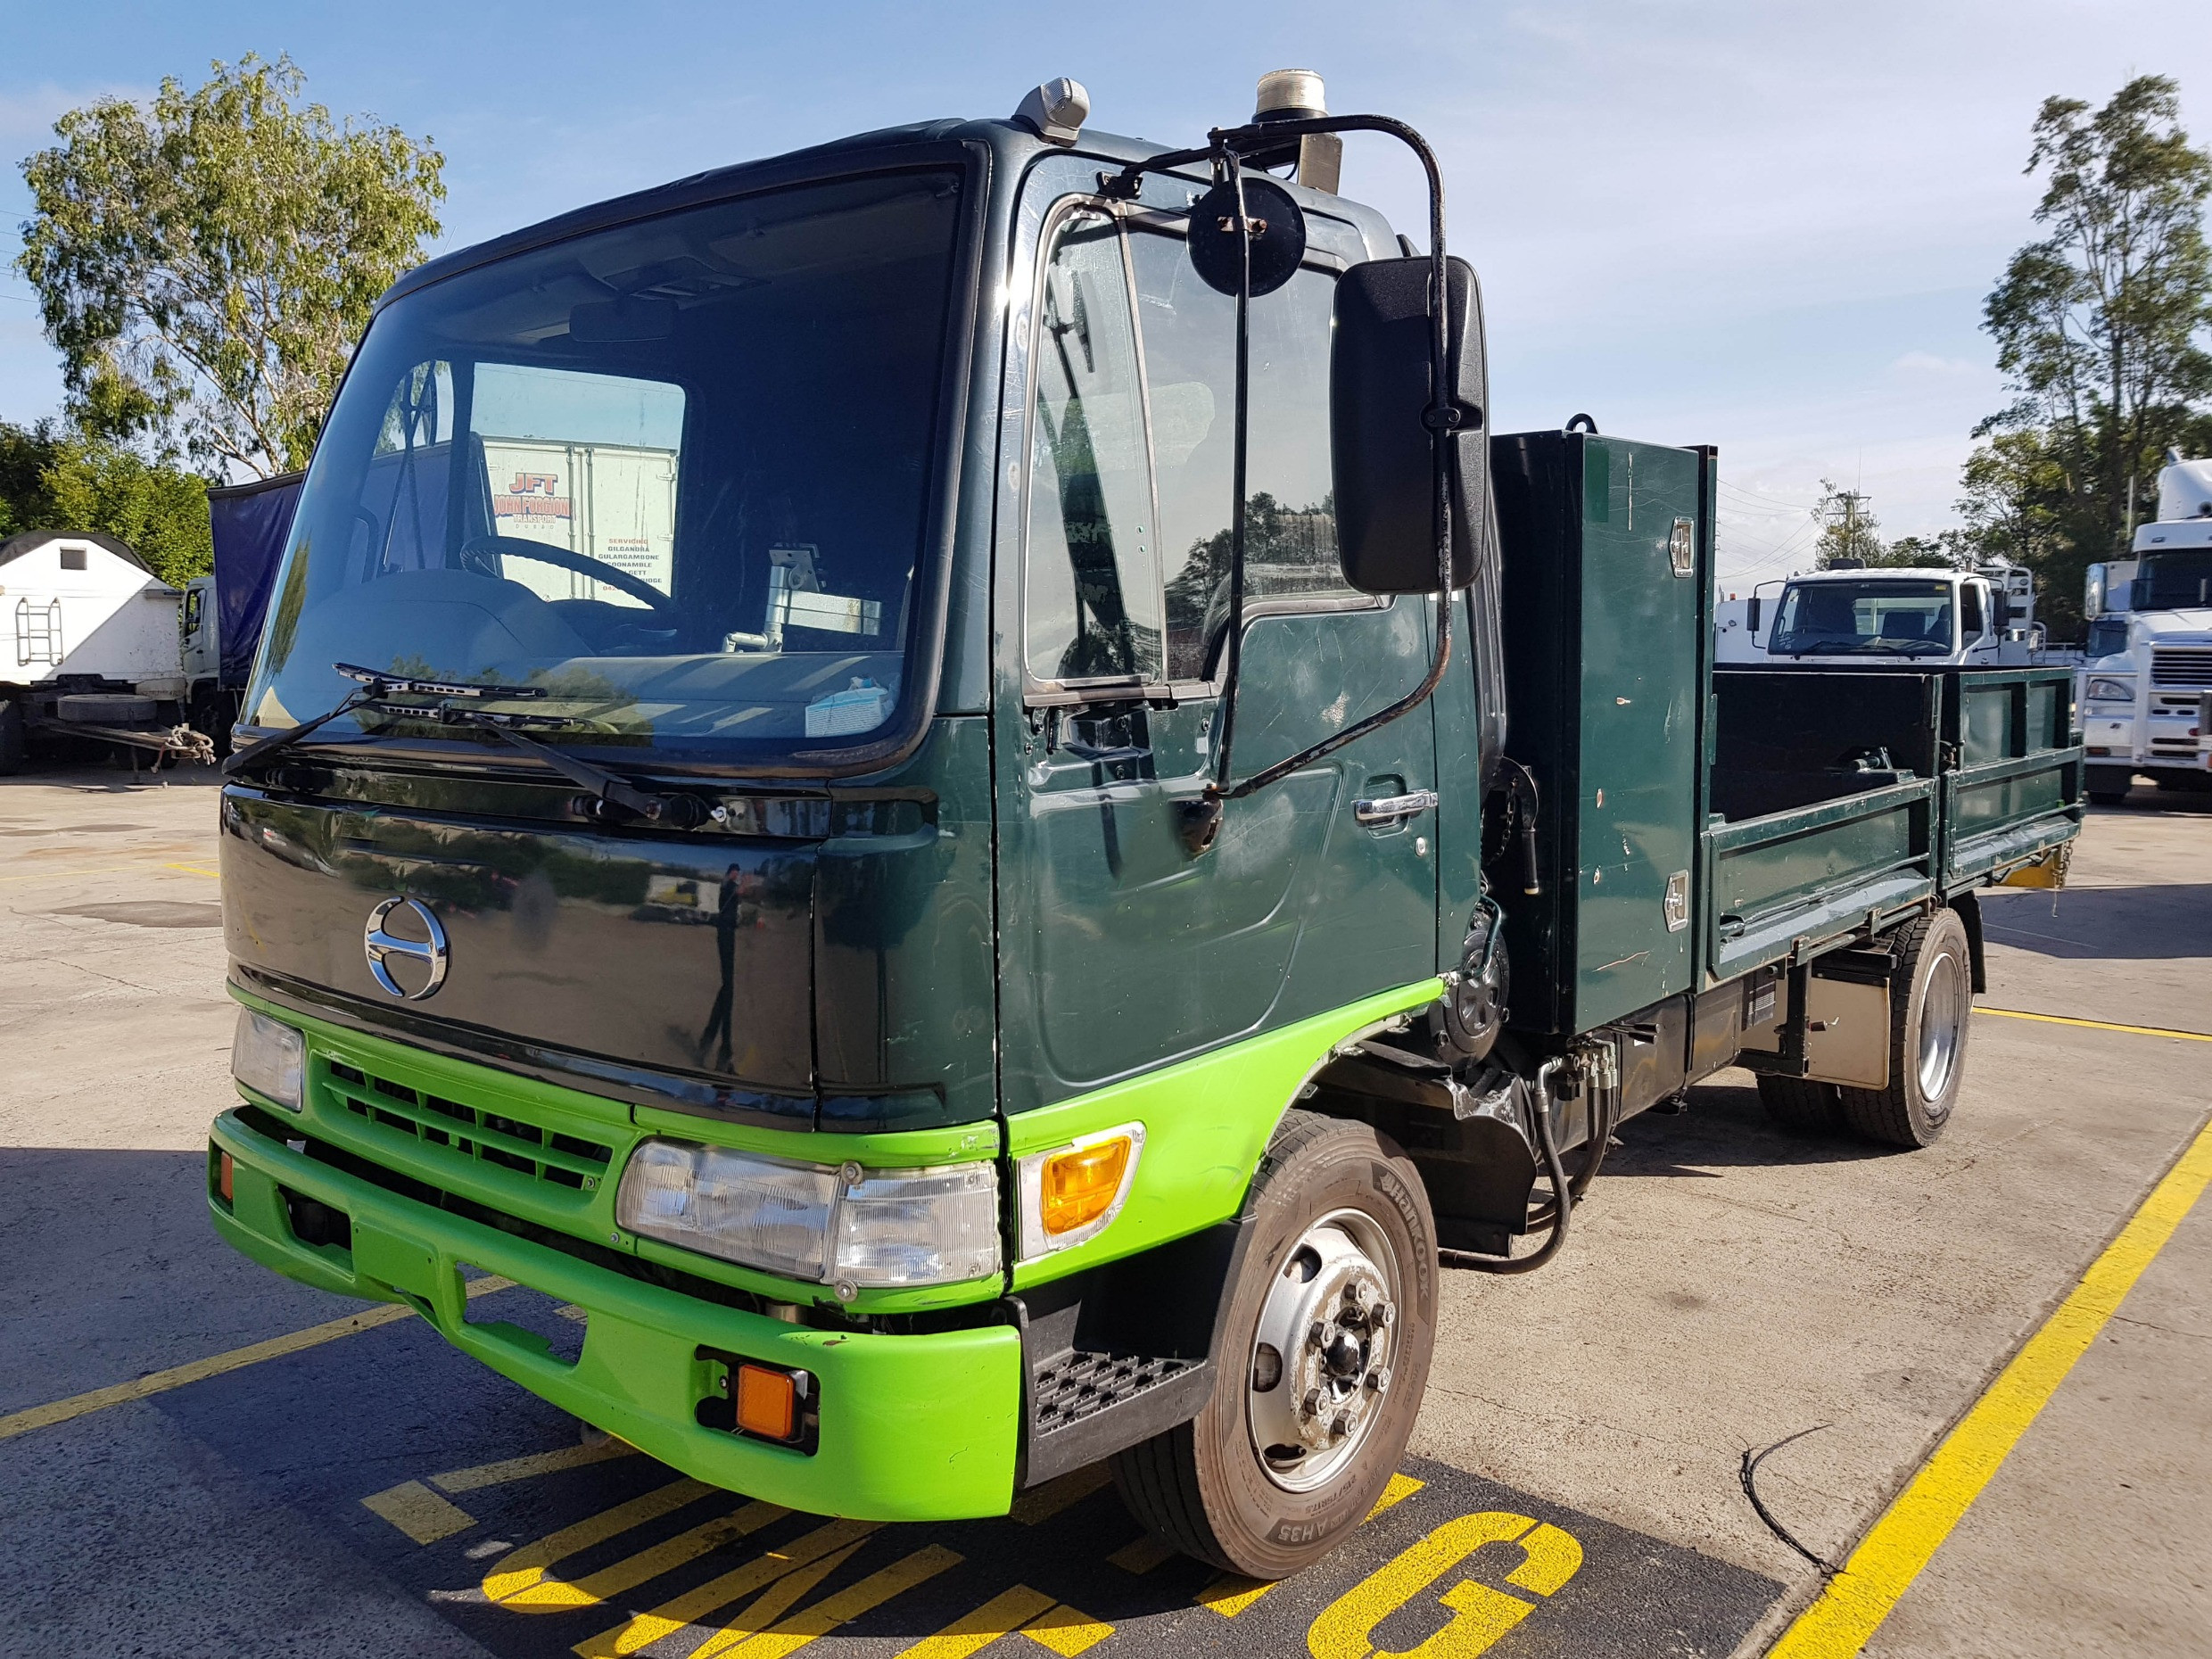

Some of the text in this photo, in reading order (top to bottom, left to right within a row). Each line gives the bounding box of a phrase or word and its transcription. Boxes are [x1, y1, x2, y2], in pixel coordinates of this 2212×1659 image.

[509, 472, 558, 496] JFT
[494, 494, 576, 520] JOHN FORGION
[514, 514, 557, 524] TRANSPORT
[1278, 1517, 1328, 1542] AH35
